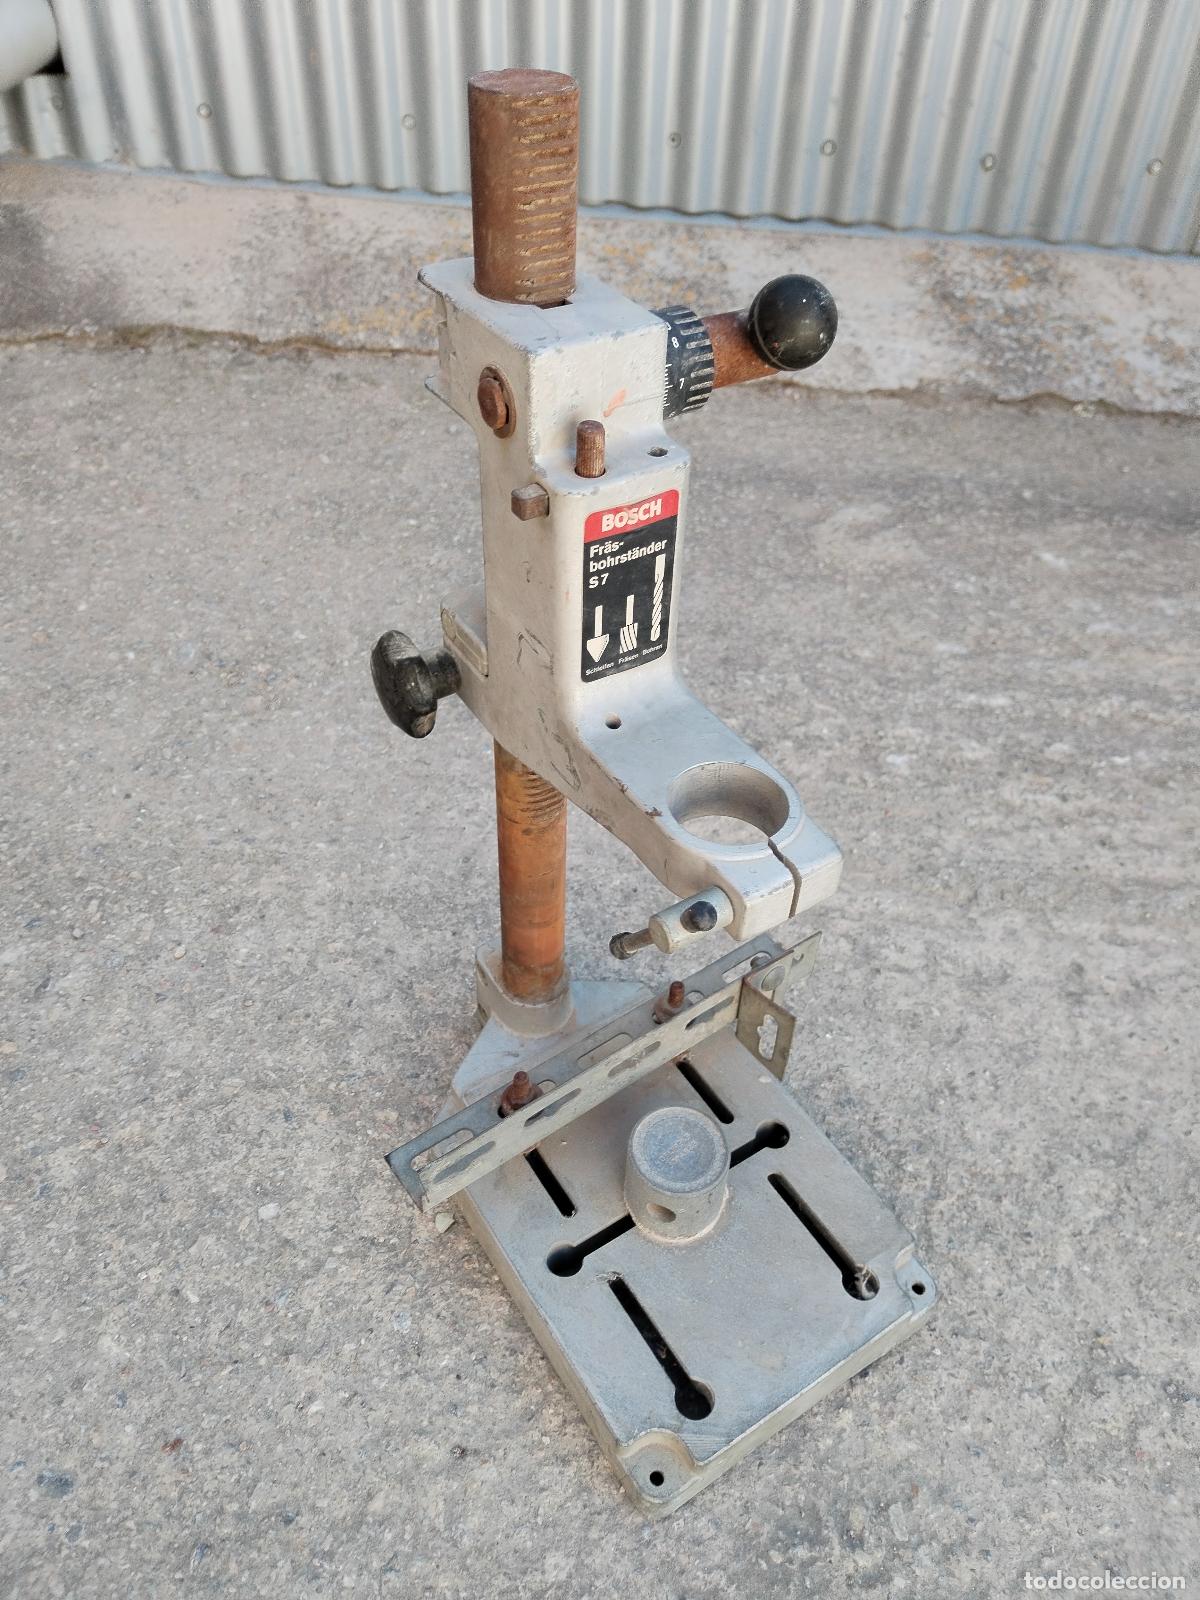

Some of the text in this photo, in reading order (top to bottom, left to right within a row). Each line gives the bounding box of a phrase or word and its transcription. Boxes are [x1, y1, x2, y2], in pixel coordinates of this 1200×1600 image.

[671, 336, 680, 349] 8
[679, 377, 685, 390] 7
[601, 498, 662, 533] BOSCH
[589, 540, 624, 559] Fräs-
[589, 539, 668, 573] bohrständer
[588, 572, 609, 589] S 7
